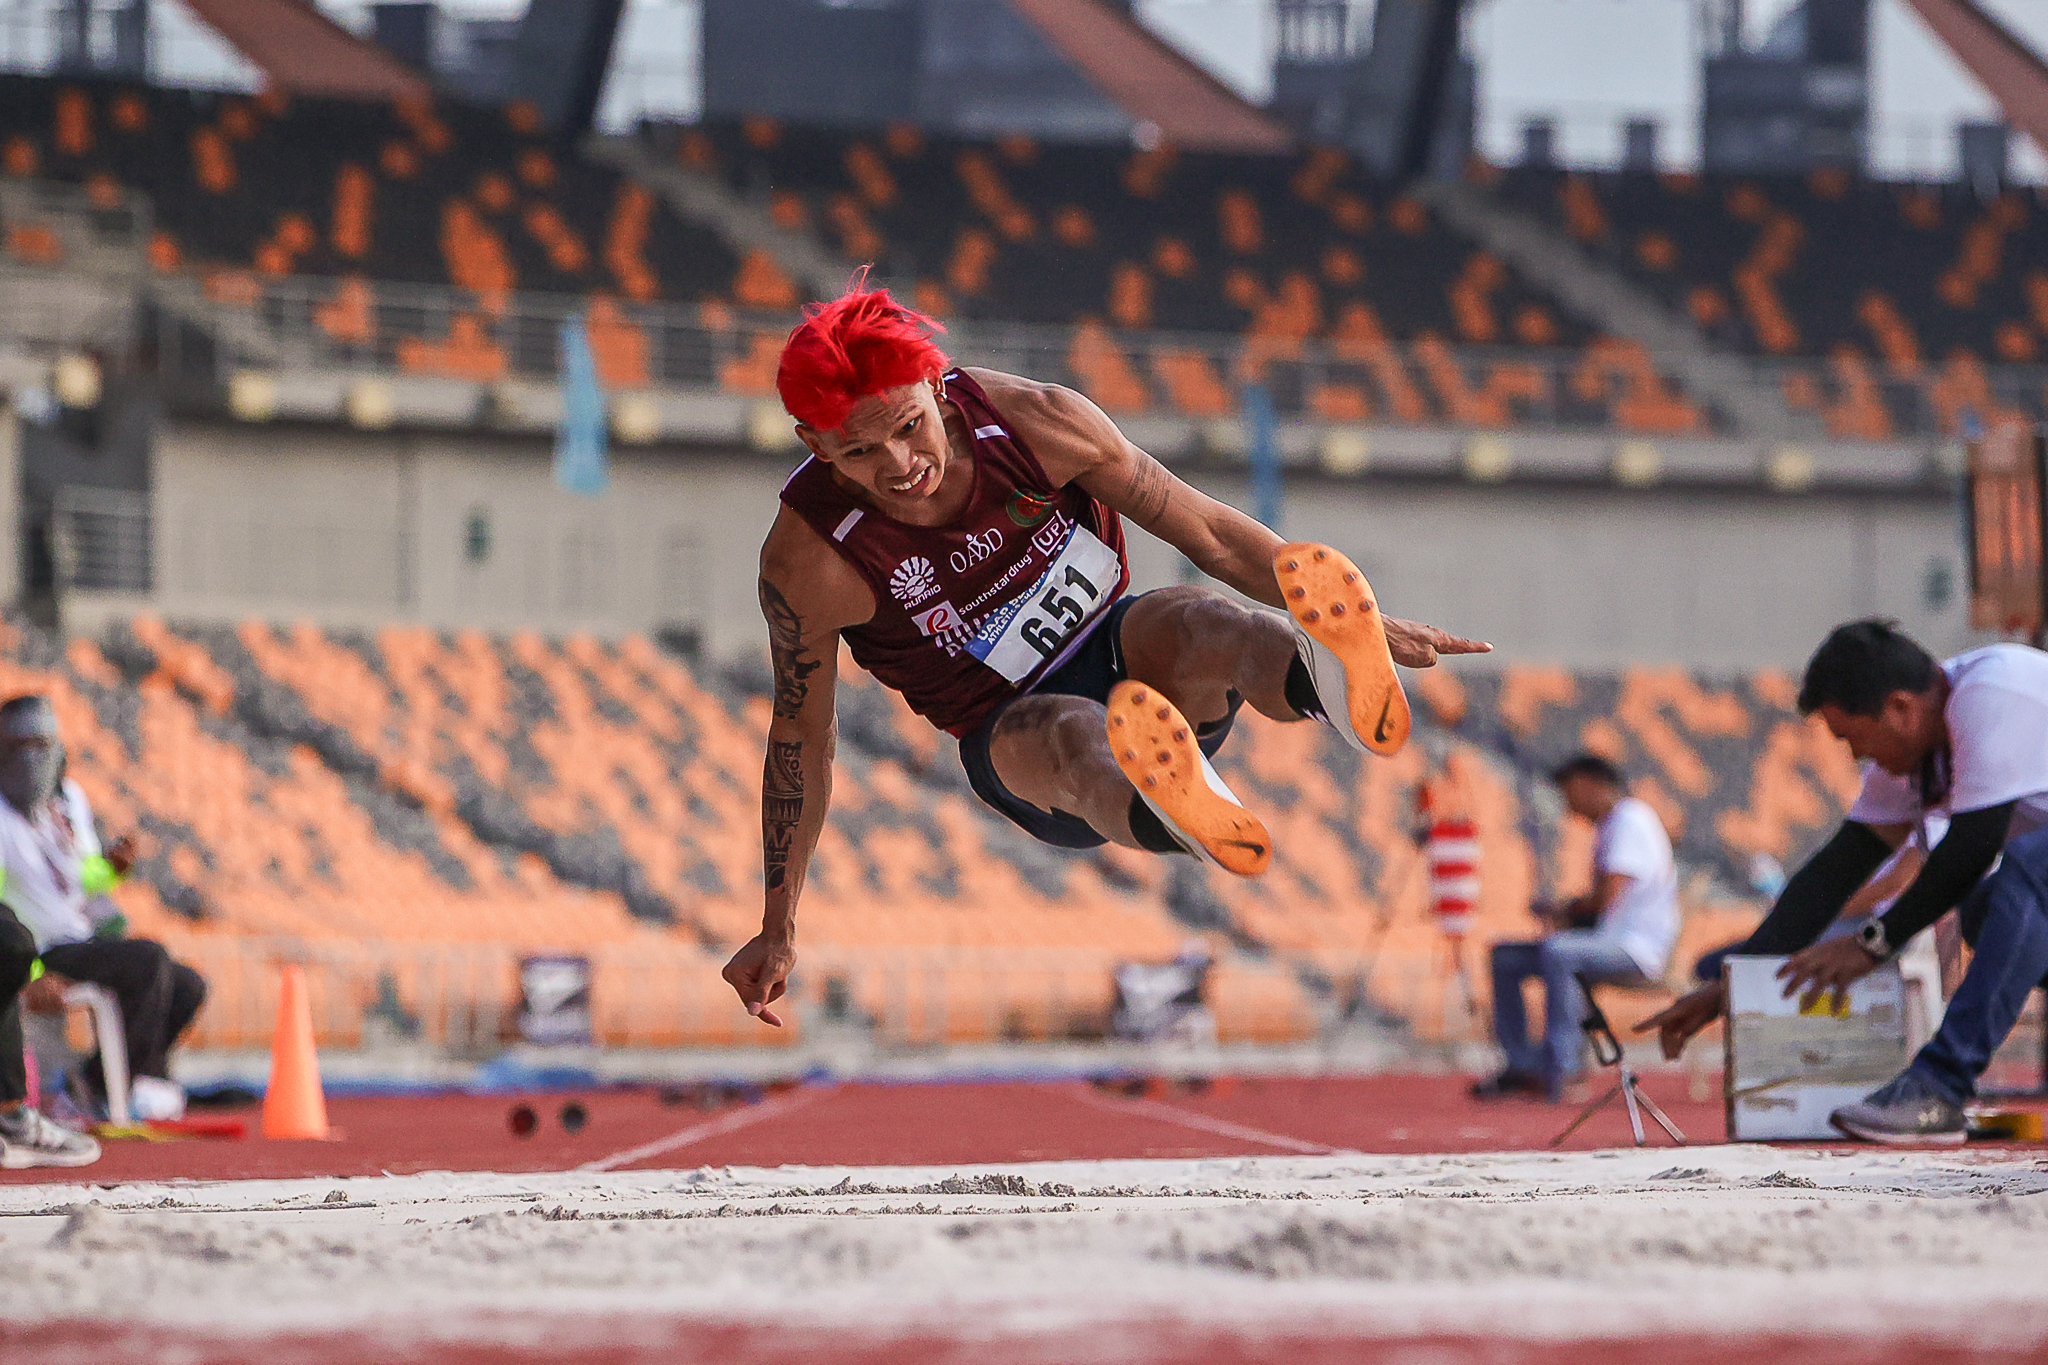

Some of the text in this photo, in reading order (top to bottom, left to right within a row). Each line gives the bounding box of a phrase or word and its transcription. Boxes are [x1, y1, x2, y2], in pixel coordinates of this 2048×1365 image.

[1038, 522, 1061, 547] UP
[958, 554, 1034, 616] southstardrug
[1020, 564, 1099, 658] 651
